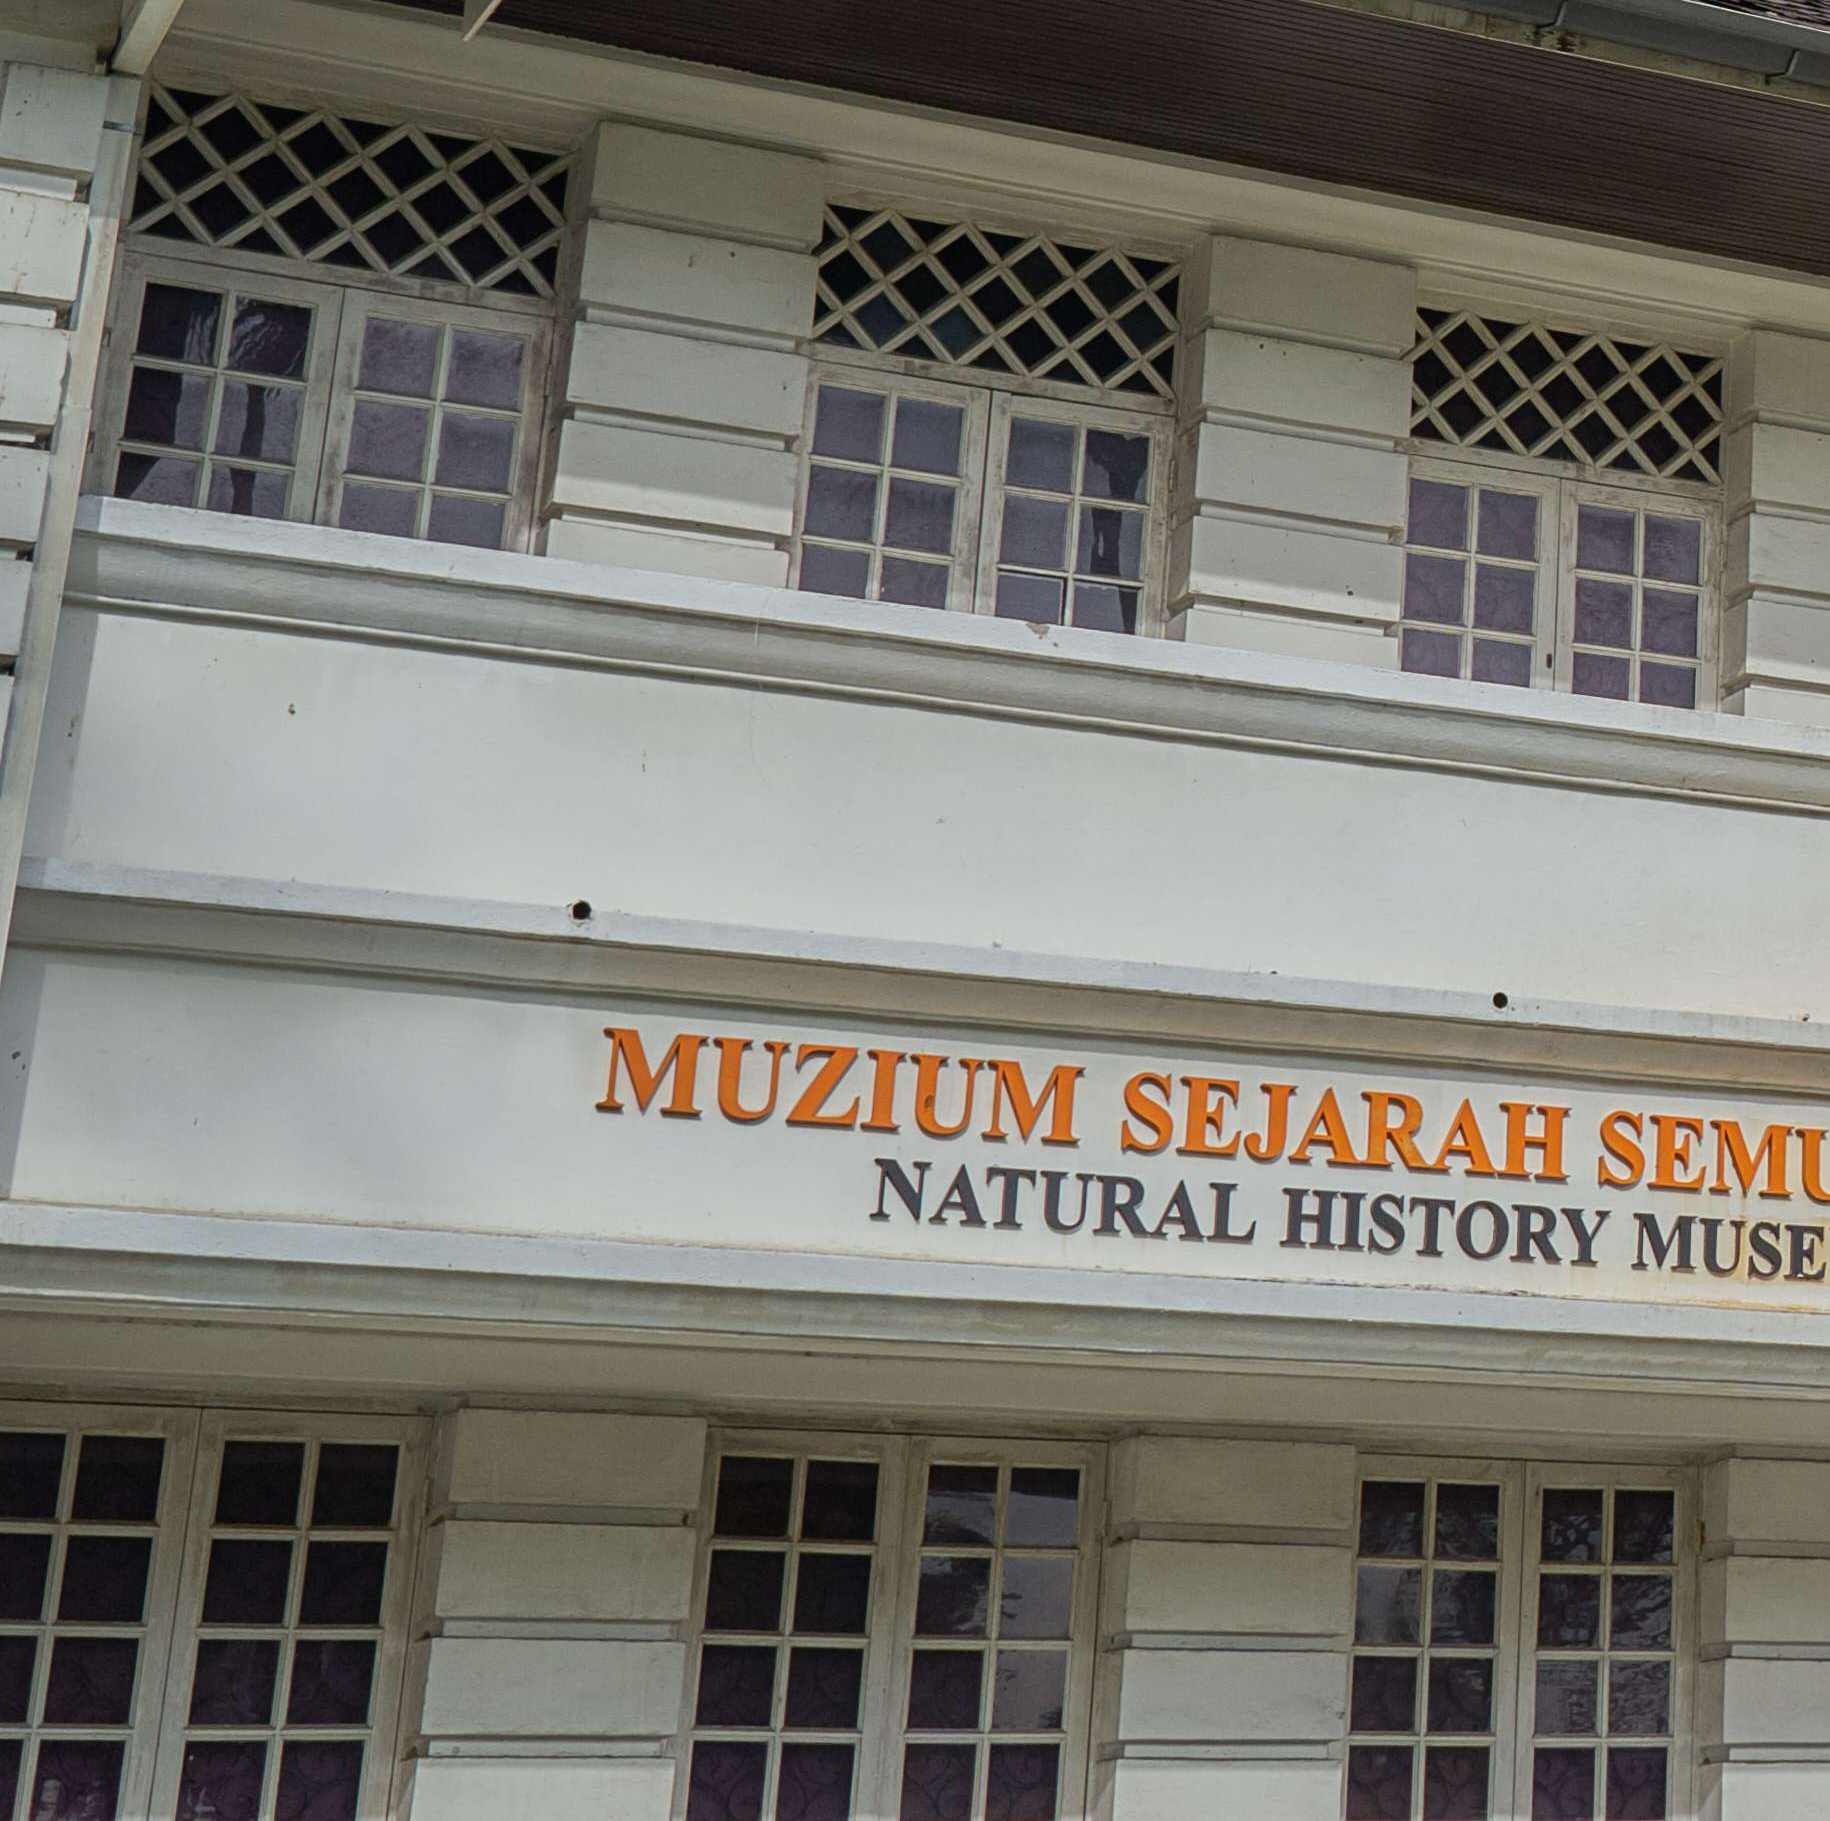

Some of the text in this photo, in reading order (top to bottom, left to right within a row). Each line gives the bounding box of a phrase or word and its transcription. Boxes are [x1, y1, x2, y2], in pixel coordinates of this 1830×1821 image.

[598, 1029, 1082, 1149] MUZIUM
[1120, 1072, 1569, 1184] SEJARAH
[871, 1159, 1258, 1246] NATURAL
[1280, 1188, 1612, 1268] HISTORY
